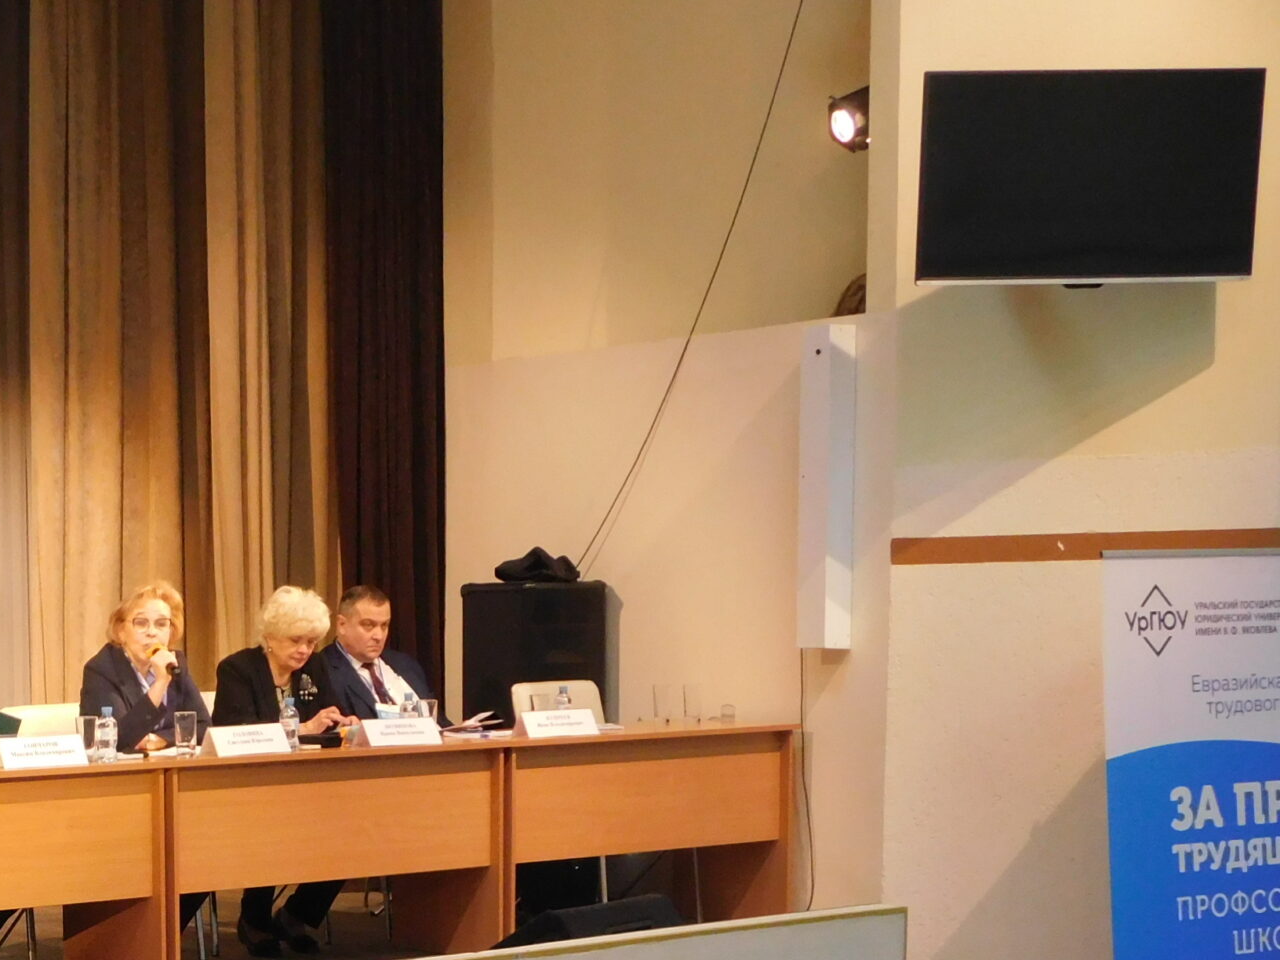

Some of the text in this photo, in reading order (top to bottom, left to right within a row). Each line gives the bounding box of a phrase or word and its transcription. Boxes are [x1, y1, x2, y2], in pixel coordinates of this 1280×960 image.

[1125, 609, 1188, 636] УрГЮУ
[1206, 698, 1280, 720] трудовог
[1170, 785, 1224, 831] ЗА
